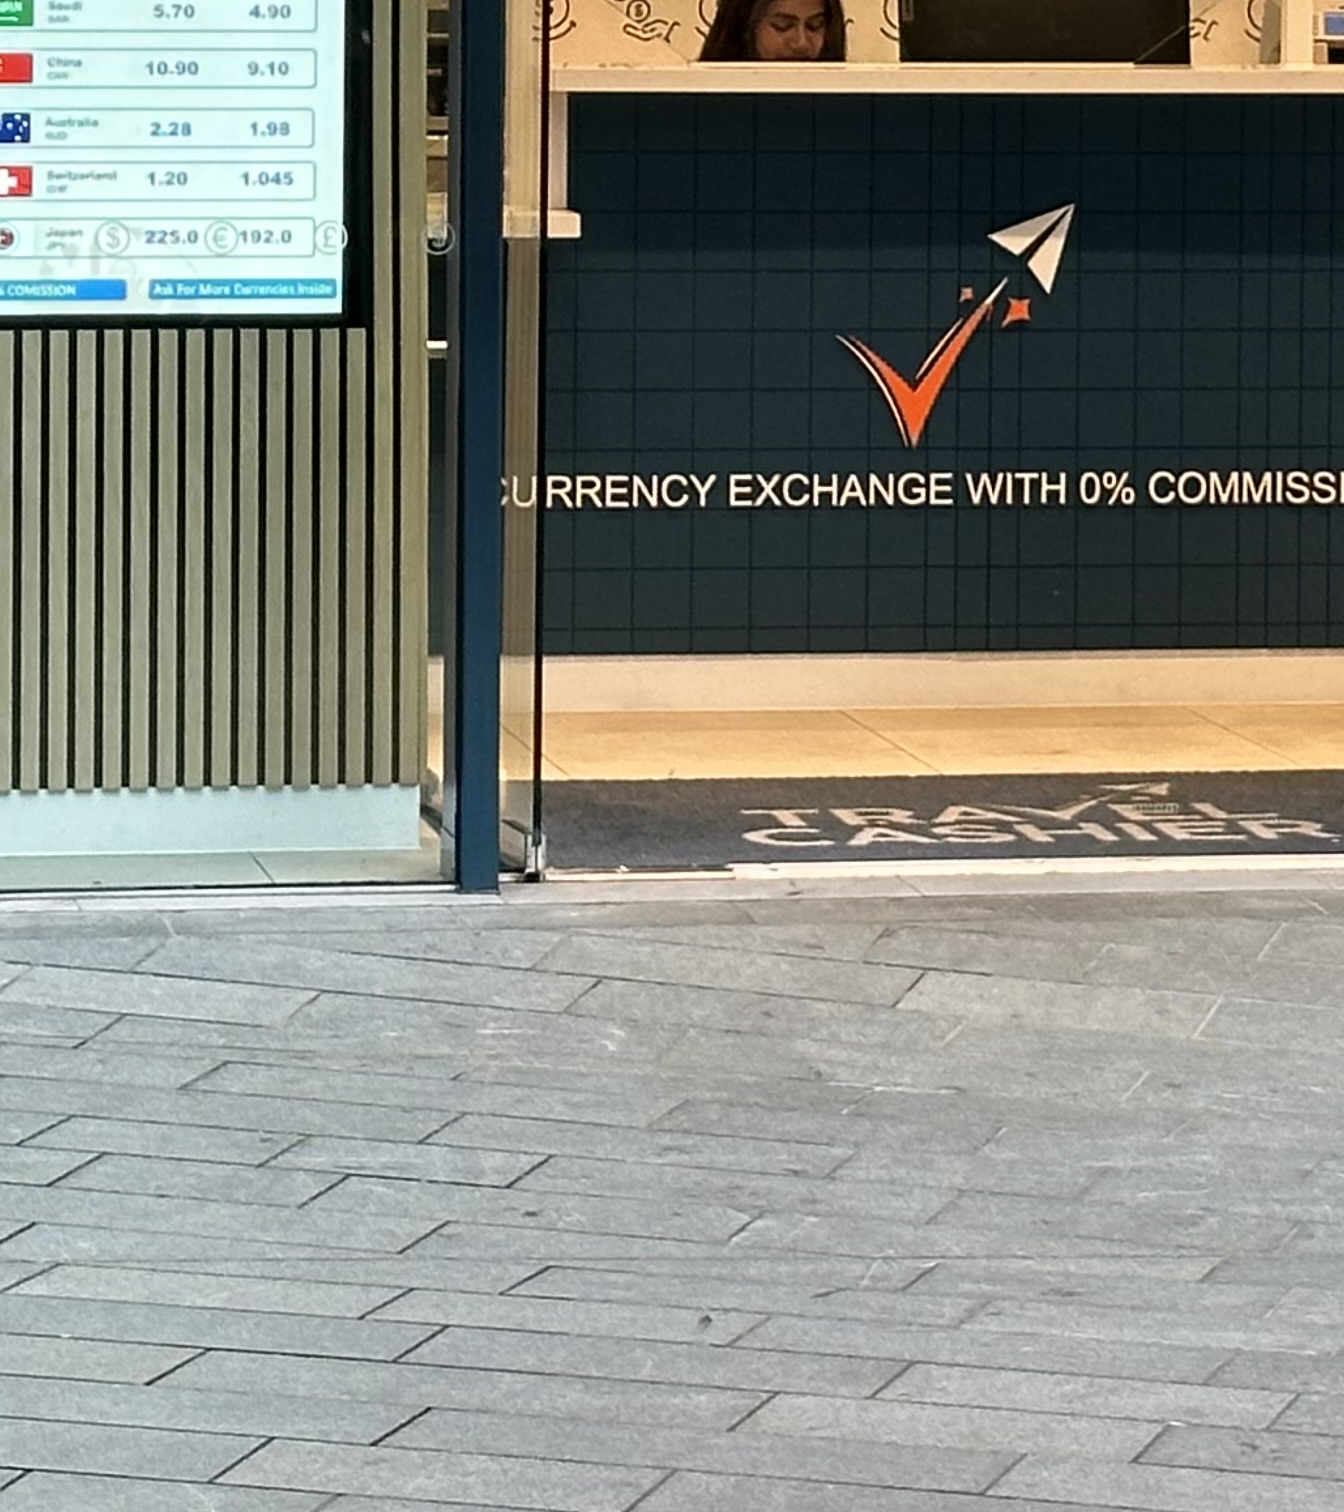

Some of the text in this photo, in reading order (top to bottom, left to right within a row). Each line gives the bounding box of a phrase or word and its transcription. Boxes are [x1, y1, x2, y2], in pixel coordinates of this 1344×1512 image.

[153, 4, 196, 20] 5.70
[248, 3, 292, 20] 4.90
[145, 61, 200, 76] 10.90
[247, 61, 290, 77] 9.10
[150, 121, 192, 138] 2.28
[249, 121, 291, 138] 1.98
[147, 171, 189, 187] 1.20
[240, 171, 294, 187] 1.045
[144, 229, 199, 245] 225.0
[237, 229, 293, 245] 192.0
[7, 284, 77, 297] COMISSION
[152, 283, 175, 295] Ask
[176, 283, 197, 295] For
[198, 283, 231, 295] More
[728, 472, 954, 507] EXCHANGE
[964, 471, 1067, 506] WITH
[1079, 471, 1136, 505] 0%
[740, 796, 1279, 826] TRAVEL
[742, 818, 1344, 846] CASHIER
